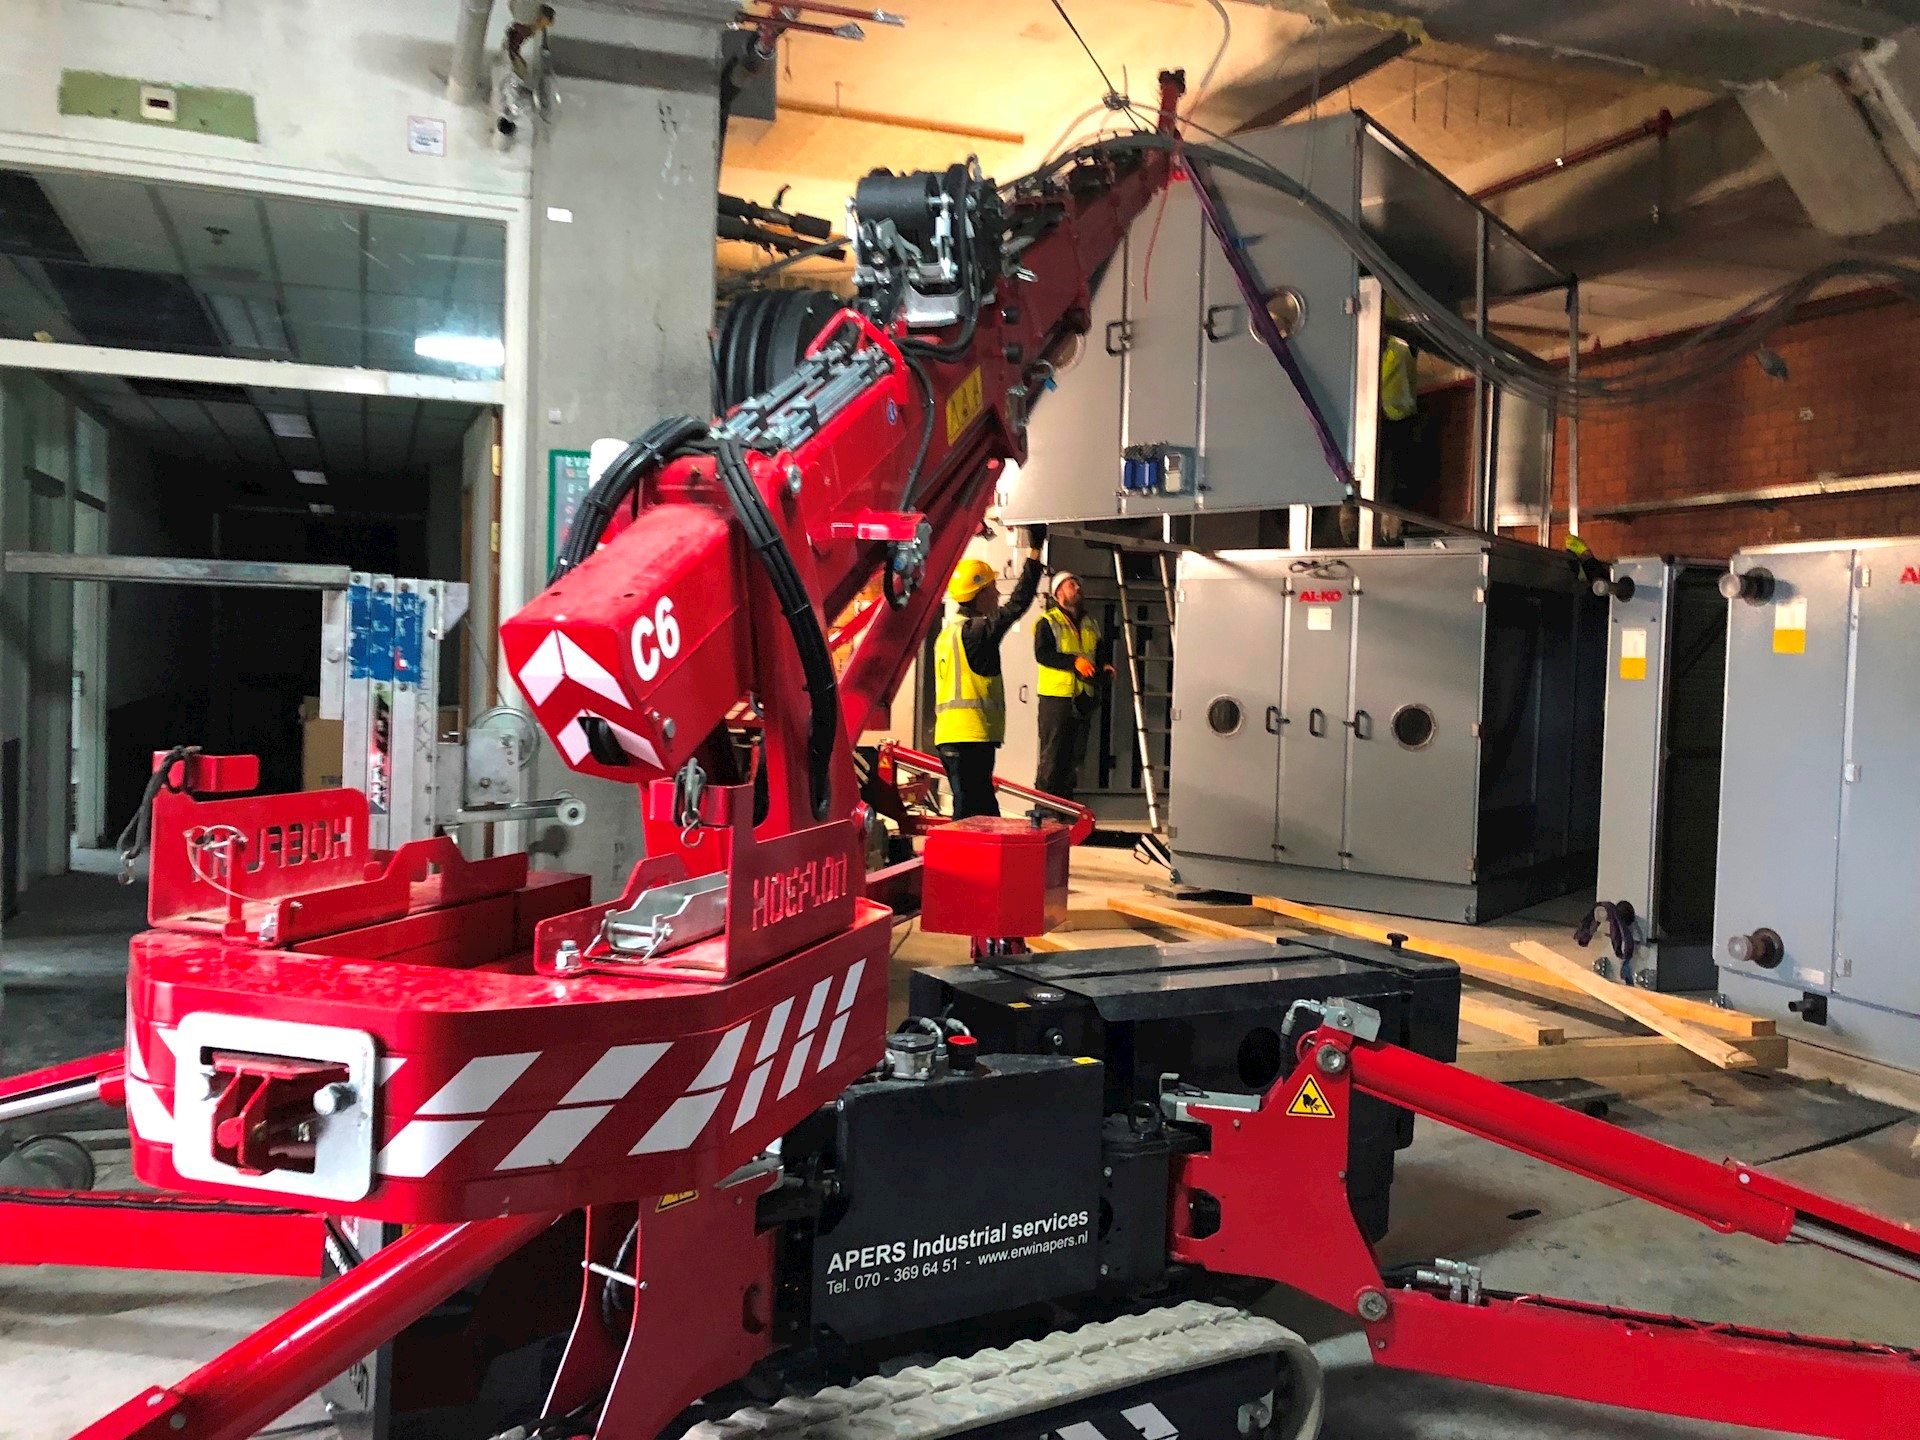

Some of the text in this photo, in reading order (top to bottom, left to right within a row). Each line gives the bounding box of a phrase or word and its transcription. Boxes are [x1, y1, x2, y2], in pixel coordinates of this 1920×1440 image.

[630, 594, 681, 682] C6
[752, 853, 847, 931] HOEFLON
[827, 1279, 850, 1295] Tel.
[854, 1272, 880, 1290] 070
[893, 1265, 918, 1283] 369
[922, 1260, 938, 1277] 64
[942, 1257, 957, 1273] 51
[978, 1231, 1089, 1266] www.erwinapers.nl
[828, 1210, 1089, 1274] APERS Industrial services
